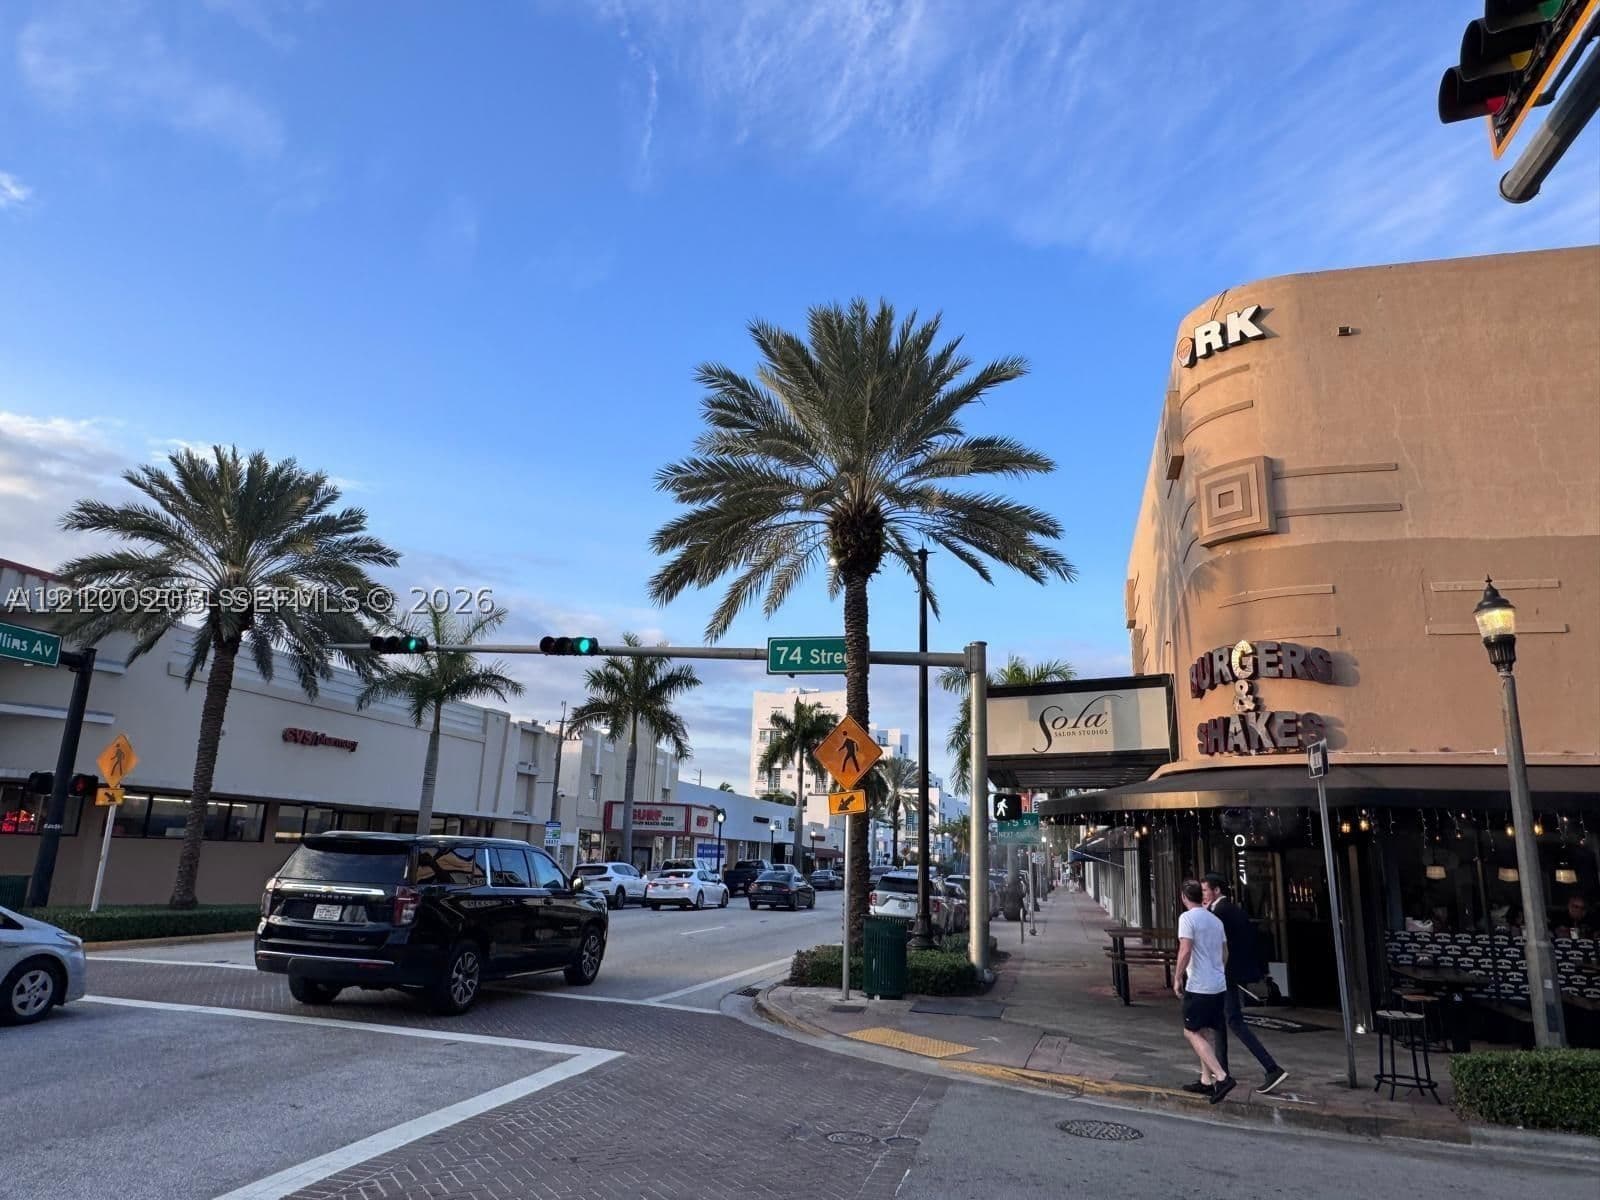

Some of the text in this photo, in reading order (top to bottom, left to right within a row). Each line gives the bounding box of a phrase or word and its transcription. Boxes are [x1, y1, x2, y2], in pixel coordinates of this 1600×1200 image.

[31, 639, 54, 658] Av
[776, 646, 803, 665] 74
[1189, 639, 1333, 699] BURGERS
[1233, 680, 1257, 712] &
[1032, 694, 1124, 753] Sola
[1078, 728, 1109, 736] STUDIOS
[1197, 711, 1327, 756] SHAKES
